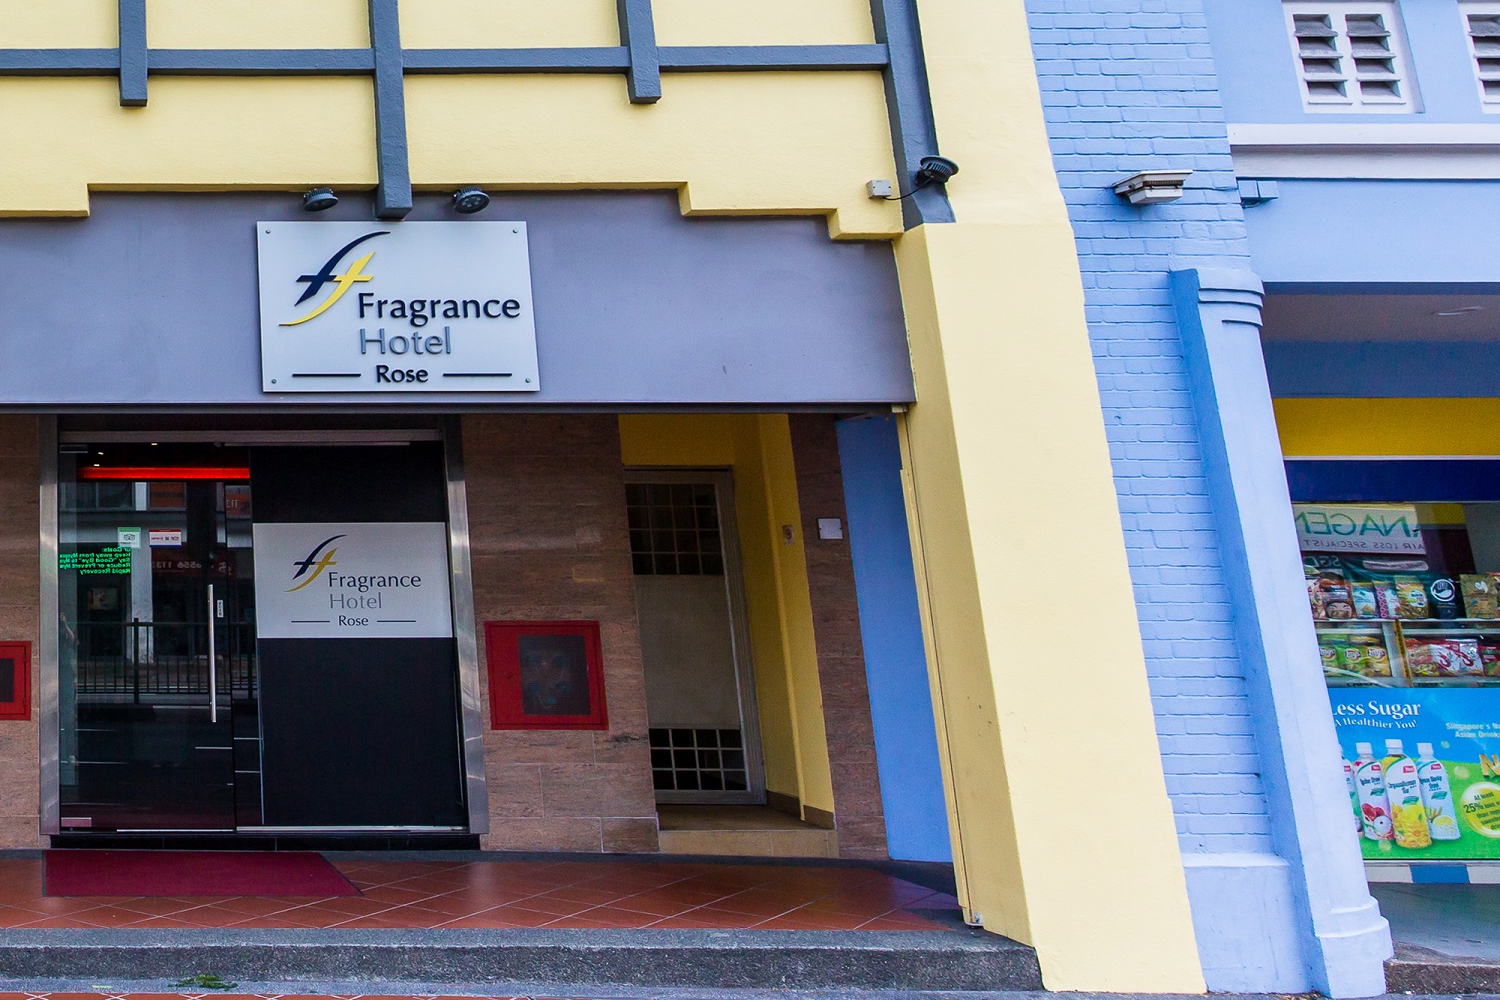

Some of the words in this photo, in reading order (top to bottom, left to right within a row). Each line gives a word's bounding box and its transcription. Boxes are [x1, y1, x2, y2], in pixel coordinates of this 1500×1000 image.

[358, 292, 520, 327] Fragrance
[359, 326, 451, 354] Hotel
[376, 364, 429, 383] Rose
[328, 571, 421, 593] Fragrance
[329, 591, 382, 609] Hotel
[338, 615, 369, 626] Rose
[1368, 700, 1421, 720] Sugar
[1343, 717, 1393, 729] Healthier
[1463, 802, 1485, 814] 25%
